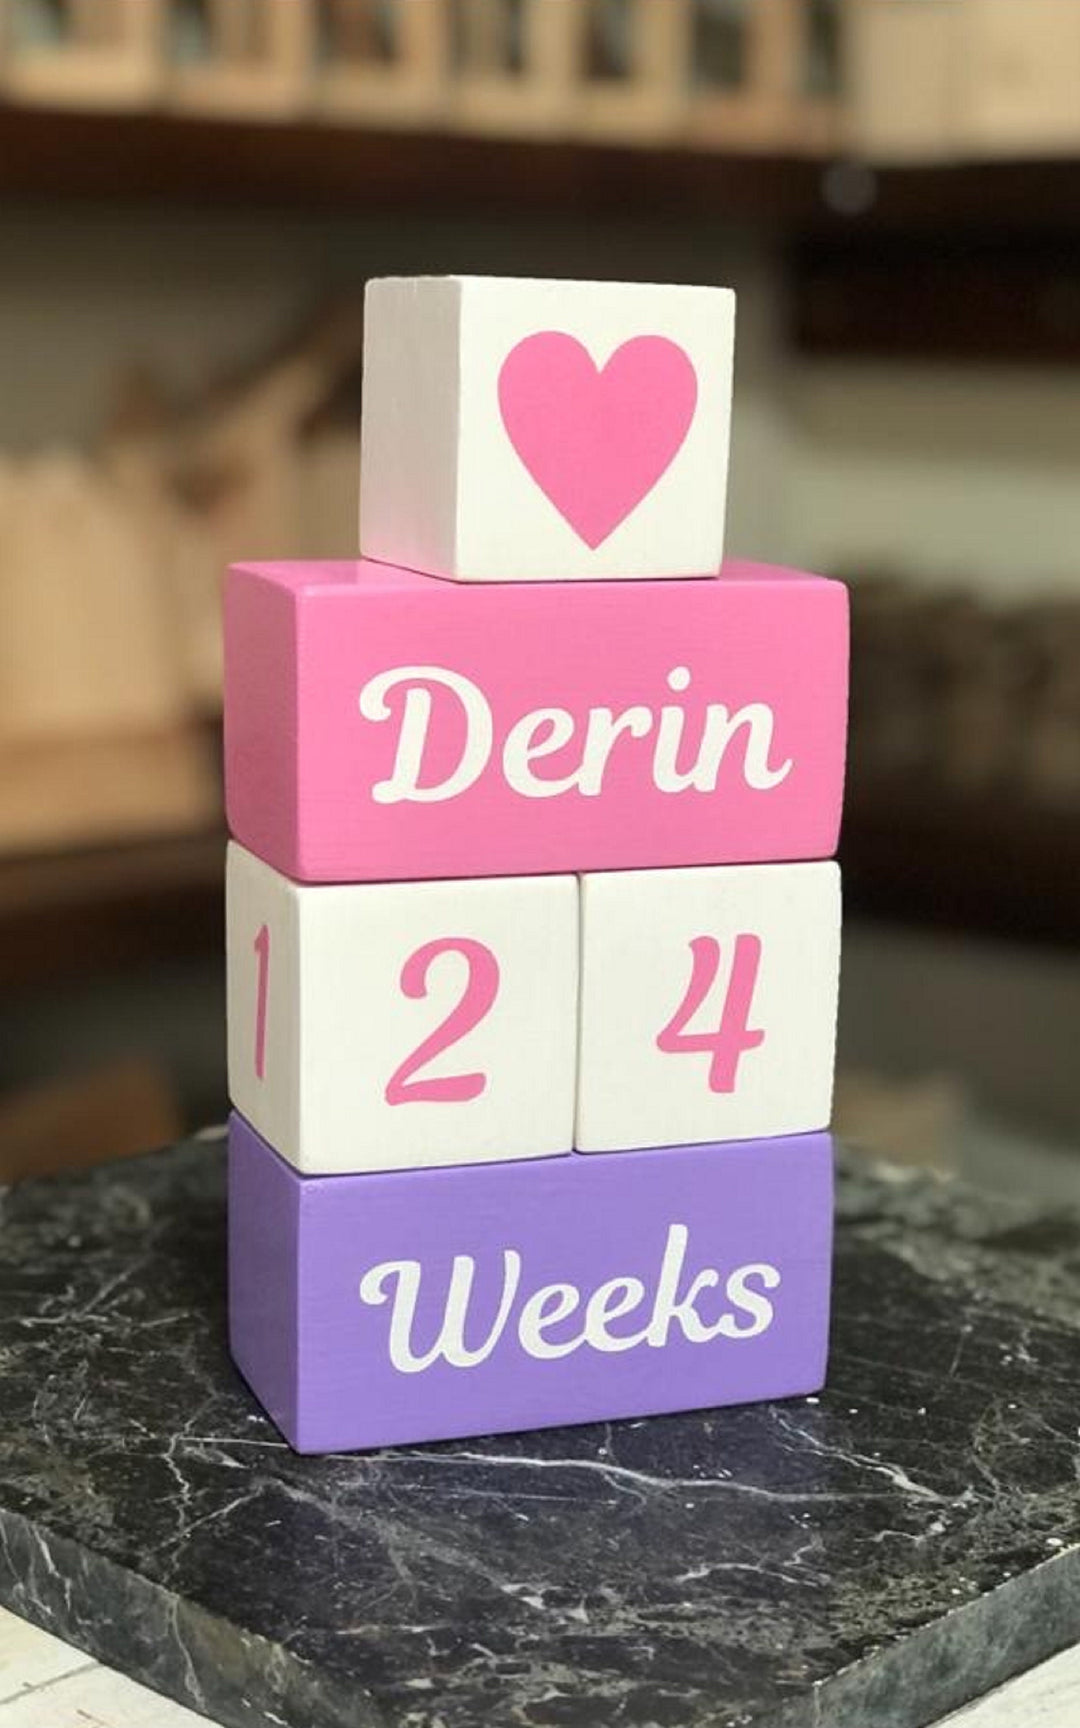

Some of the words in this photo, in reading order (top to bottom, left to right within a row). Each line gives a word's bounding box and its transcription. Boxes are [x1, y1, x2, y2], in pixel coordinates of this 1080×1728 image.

[358, 665, 793, 805] Derin
[252, 923, 271, 1081] 1
[384, 937, 502, 1106] 2
[655, 933, 765, 1094] 4
[358, 1223, 782, 1375] Weeks
